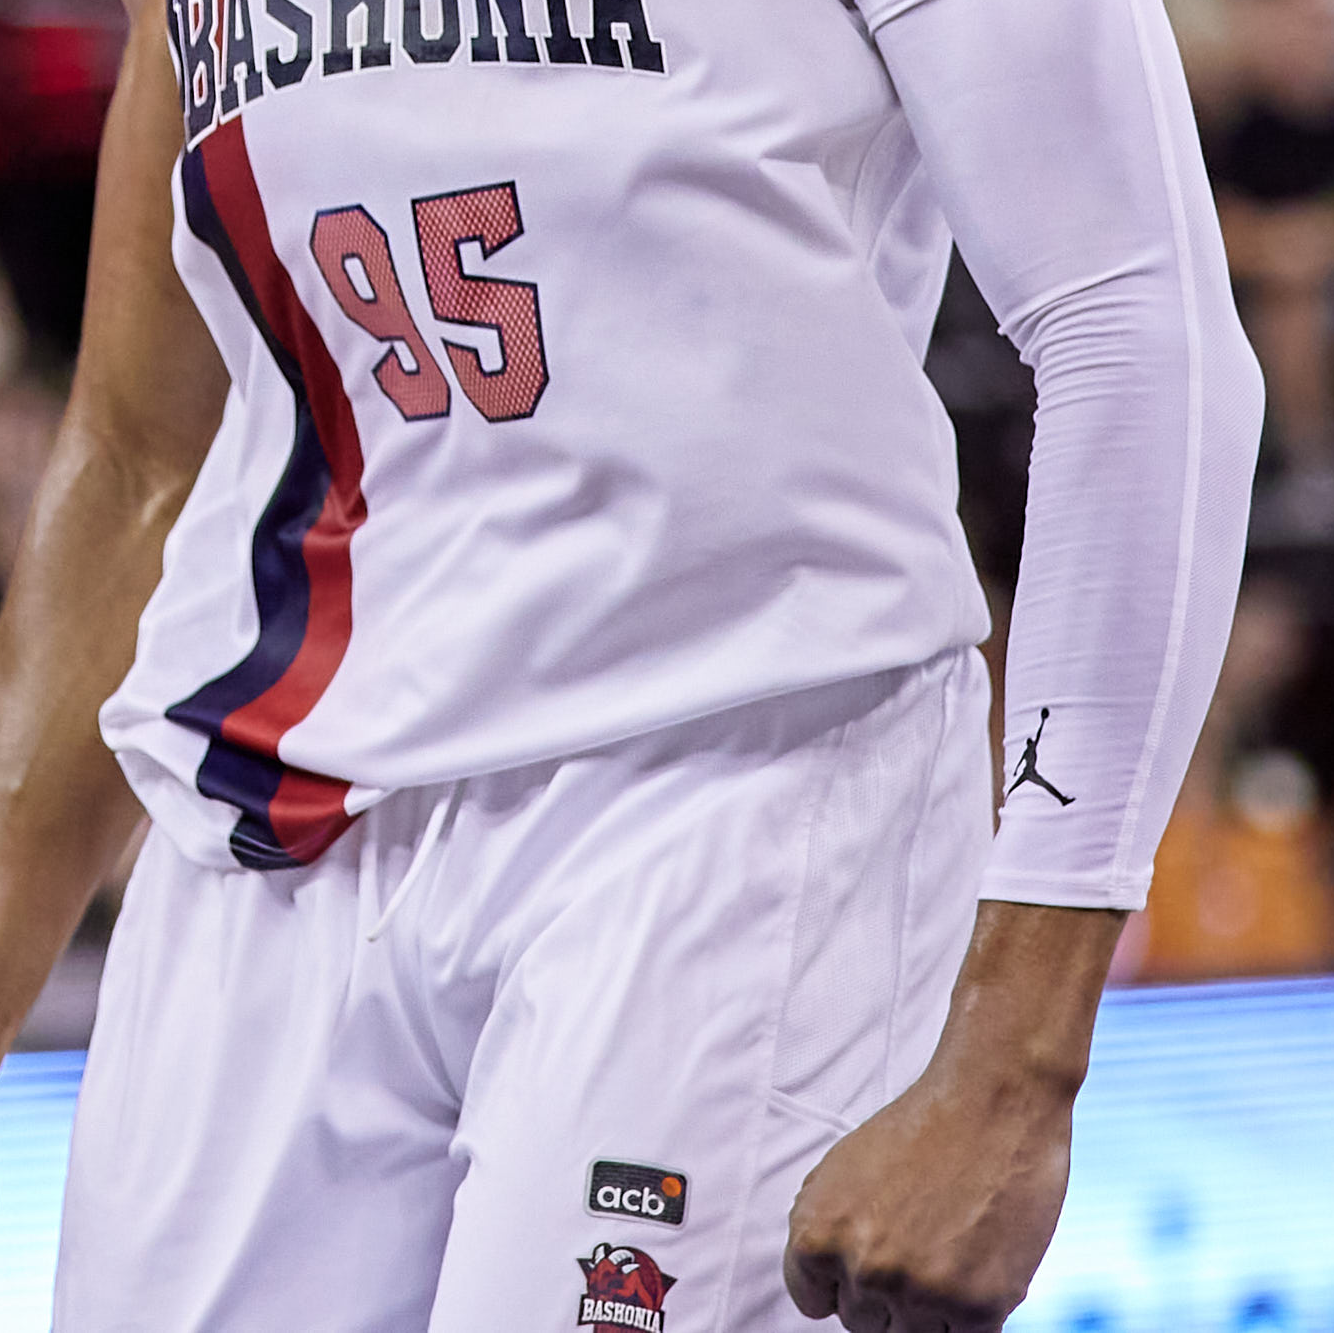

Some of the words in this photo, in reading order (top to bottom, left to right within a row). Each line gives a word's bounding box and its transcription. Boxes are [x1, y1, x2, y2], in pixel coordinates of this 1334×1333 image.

[310, 181, 549, 423] 95
[596, 1185, 665, 1216] acb
[581, 1297, 662, 1333] BASKONIA
